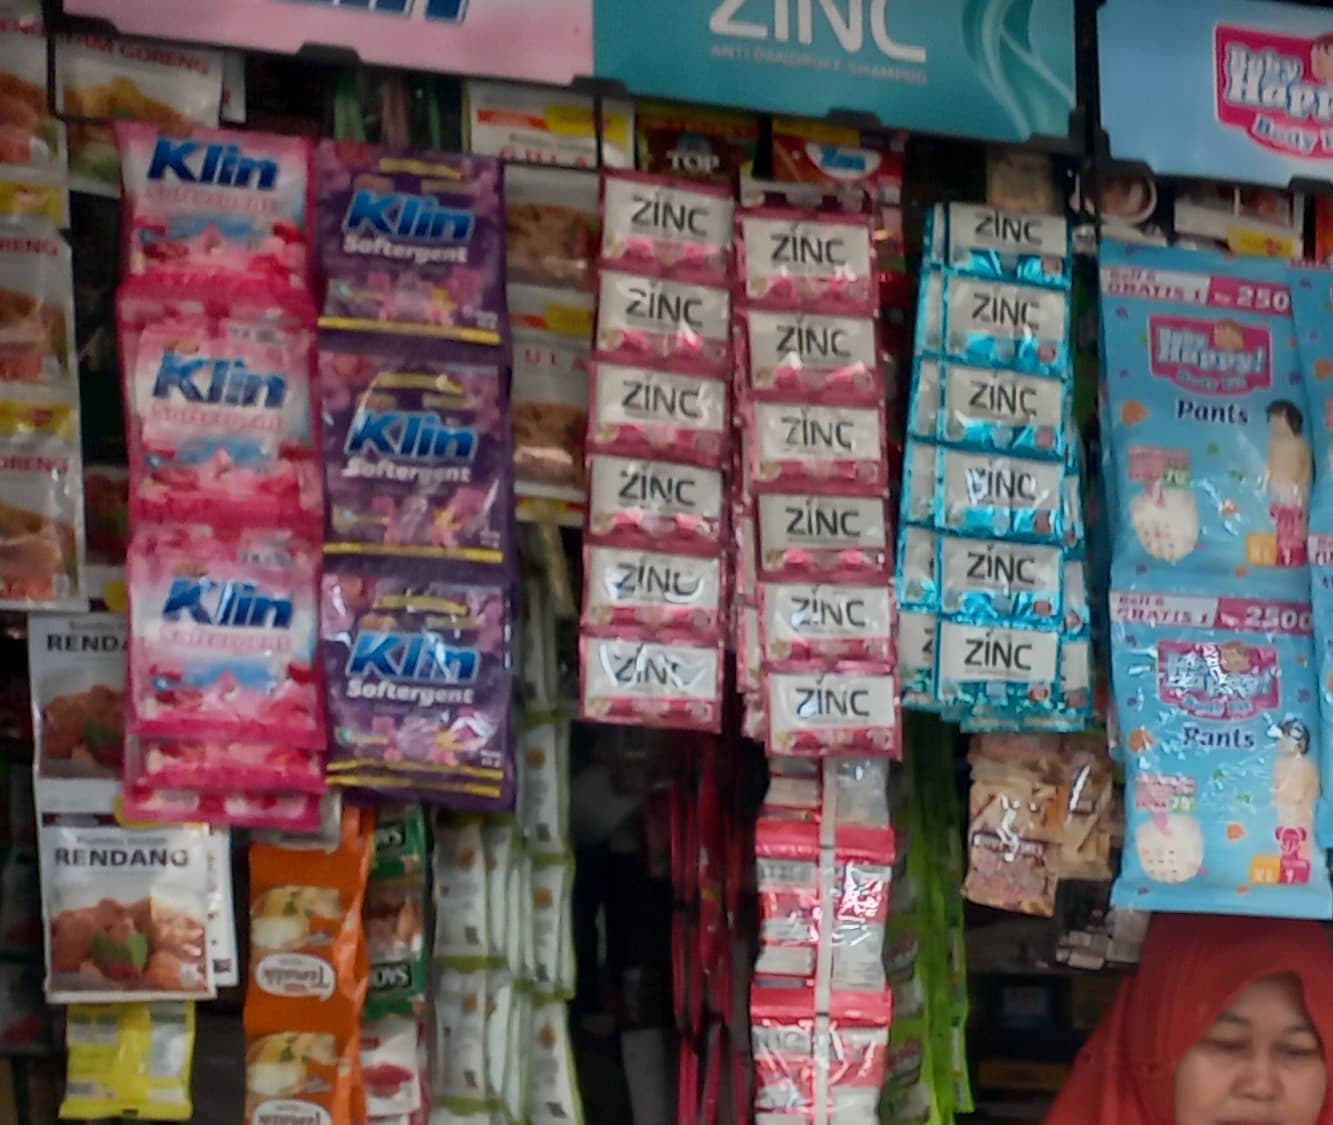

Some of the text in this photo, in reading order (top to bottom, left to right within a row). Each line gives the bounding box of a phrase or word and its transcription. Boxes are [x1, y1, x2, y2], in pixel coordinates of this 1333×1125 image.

[707, 0, 927, 64] ZINC
[711, 43, 748, 60] ANTI
[848, 62, 928, 86] SHAMPOO
[147, 138, 279, 191] Klin
[346, 189, 476, 240] Klin
[631, 194, 708, 238] ZINC
[974, 211, 1042, 245] ZINC
[770, 231, 847, 266] ZINC
[625, 286, 704, 328] ZINC
[972, 293, 1041, 328] ZINC
[776, 324, 851, 360] ZINC
[152, 350, 288, 408] Klin
[621, 376, 702, 419] ZINC
[969, 381, 1038, 417] ZINC
[1176, 399, 1249, 425] Pants
[347, 411, 478, 461] Klin
[781, 416, 853, 450] ZINC
[618, 470, 696, 507] ZINC
[786, 506, 860, 538] ZINC
[967, 552, 1035, 585] ZINC
[162, 576, 293, 629] Klin
[791, 596, 866, 629] ZINC
[349, 632, 479, 682] Klin
[964, 639, 1033, 671] ZINC
[347, 680, 474, 708] Softergent
[795, 684, 870, 717] ZINC
[1182, 722, 1255, 751] Pants
[54, 848, 189, 867] RENDANG
